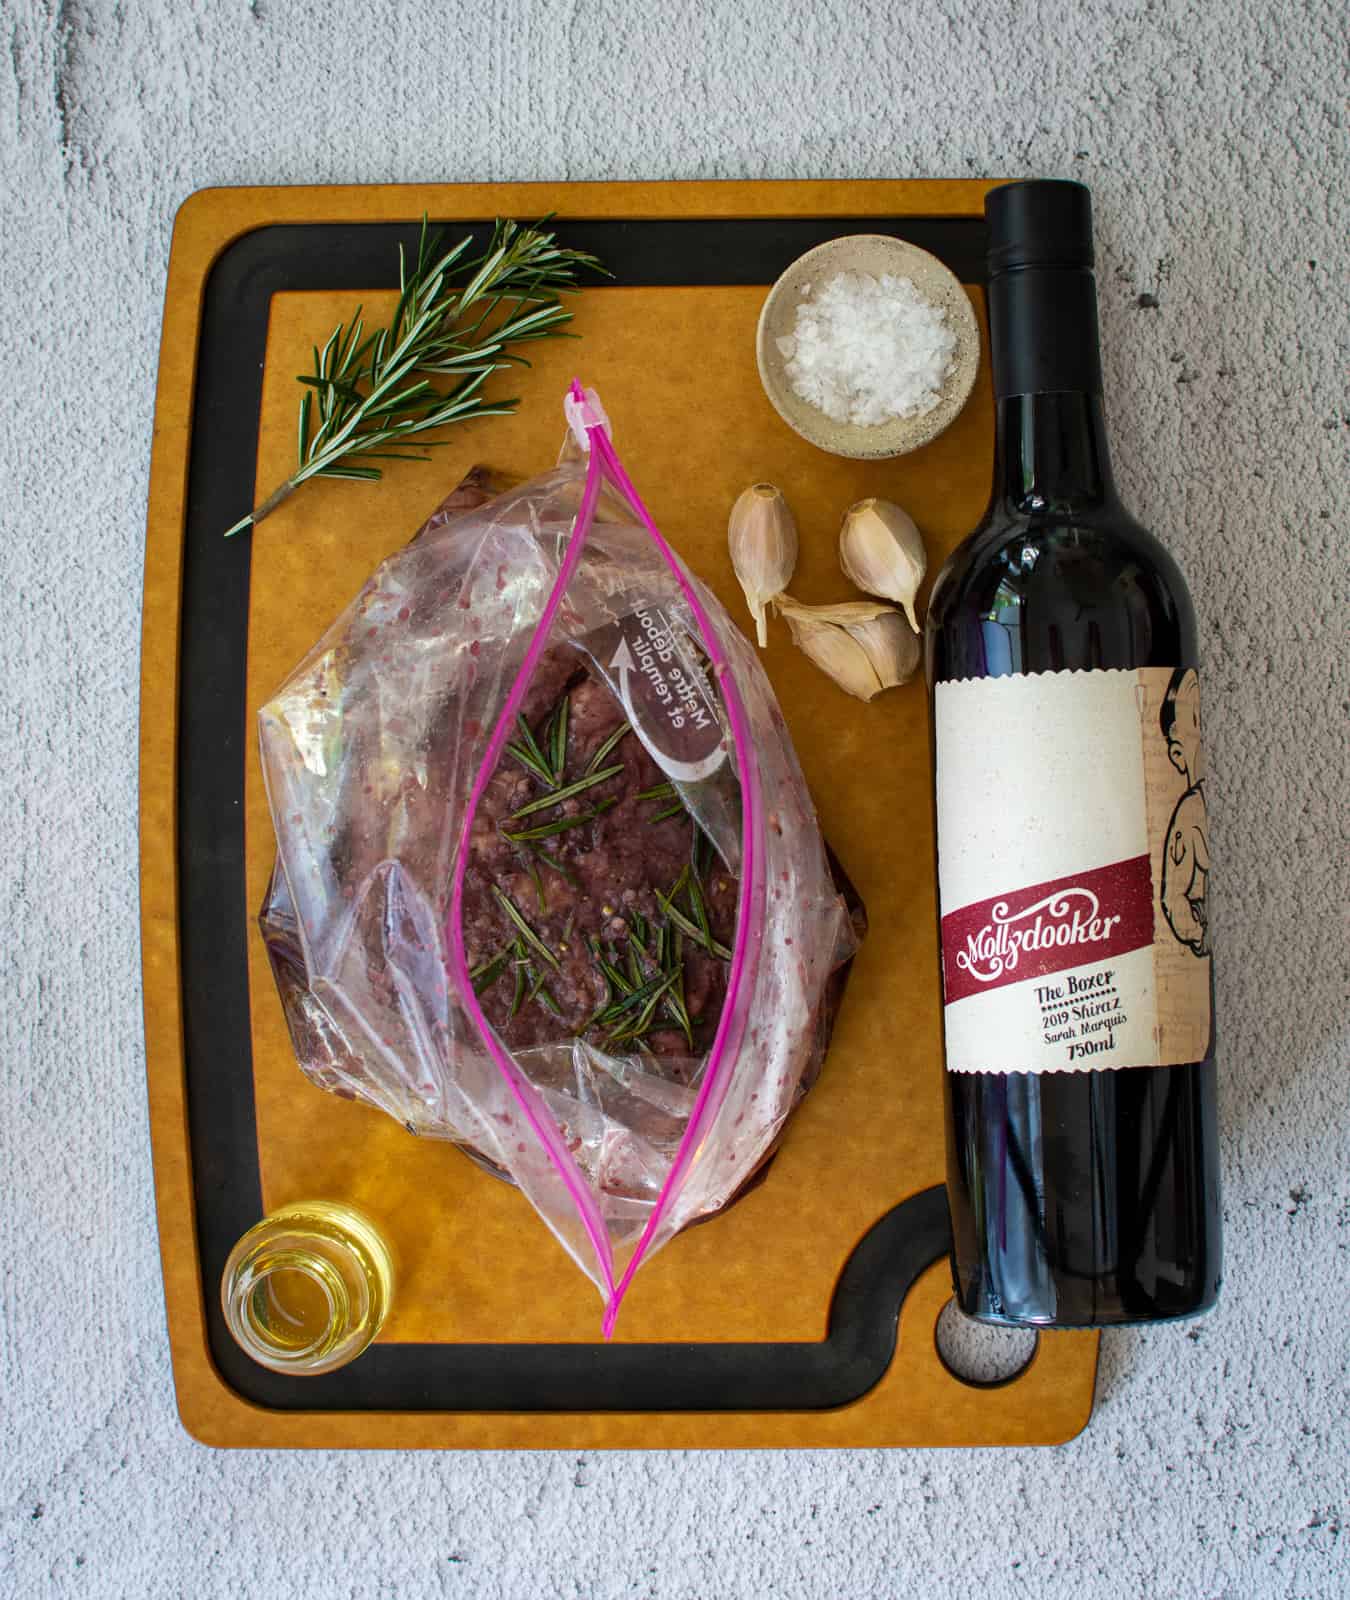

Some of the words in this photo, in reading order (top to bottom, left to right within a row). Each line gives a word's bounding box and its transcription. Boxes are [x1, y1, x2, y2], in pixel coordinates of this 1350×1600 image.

[956, 887, 1121, 982] Mollydooker
[1034, 985, 1065, 1004] The
[1066, 969, 1116, 995] Boxer
[1042, 1011, 1070, 1029] 2019
[1071, 997, 1122, 1021] Shiraz
[1044, 1026, 1077, 1045] Sarah
[1080, 1013, 1128, 1036] Marquis
[1066, 1033, 1116, 1061] 750ml
